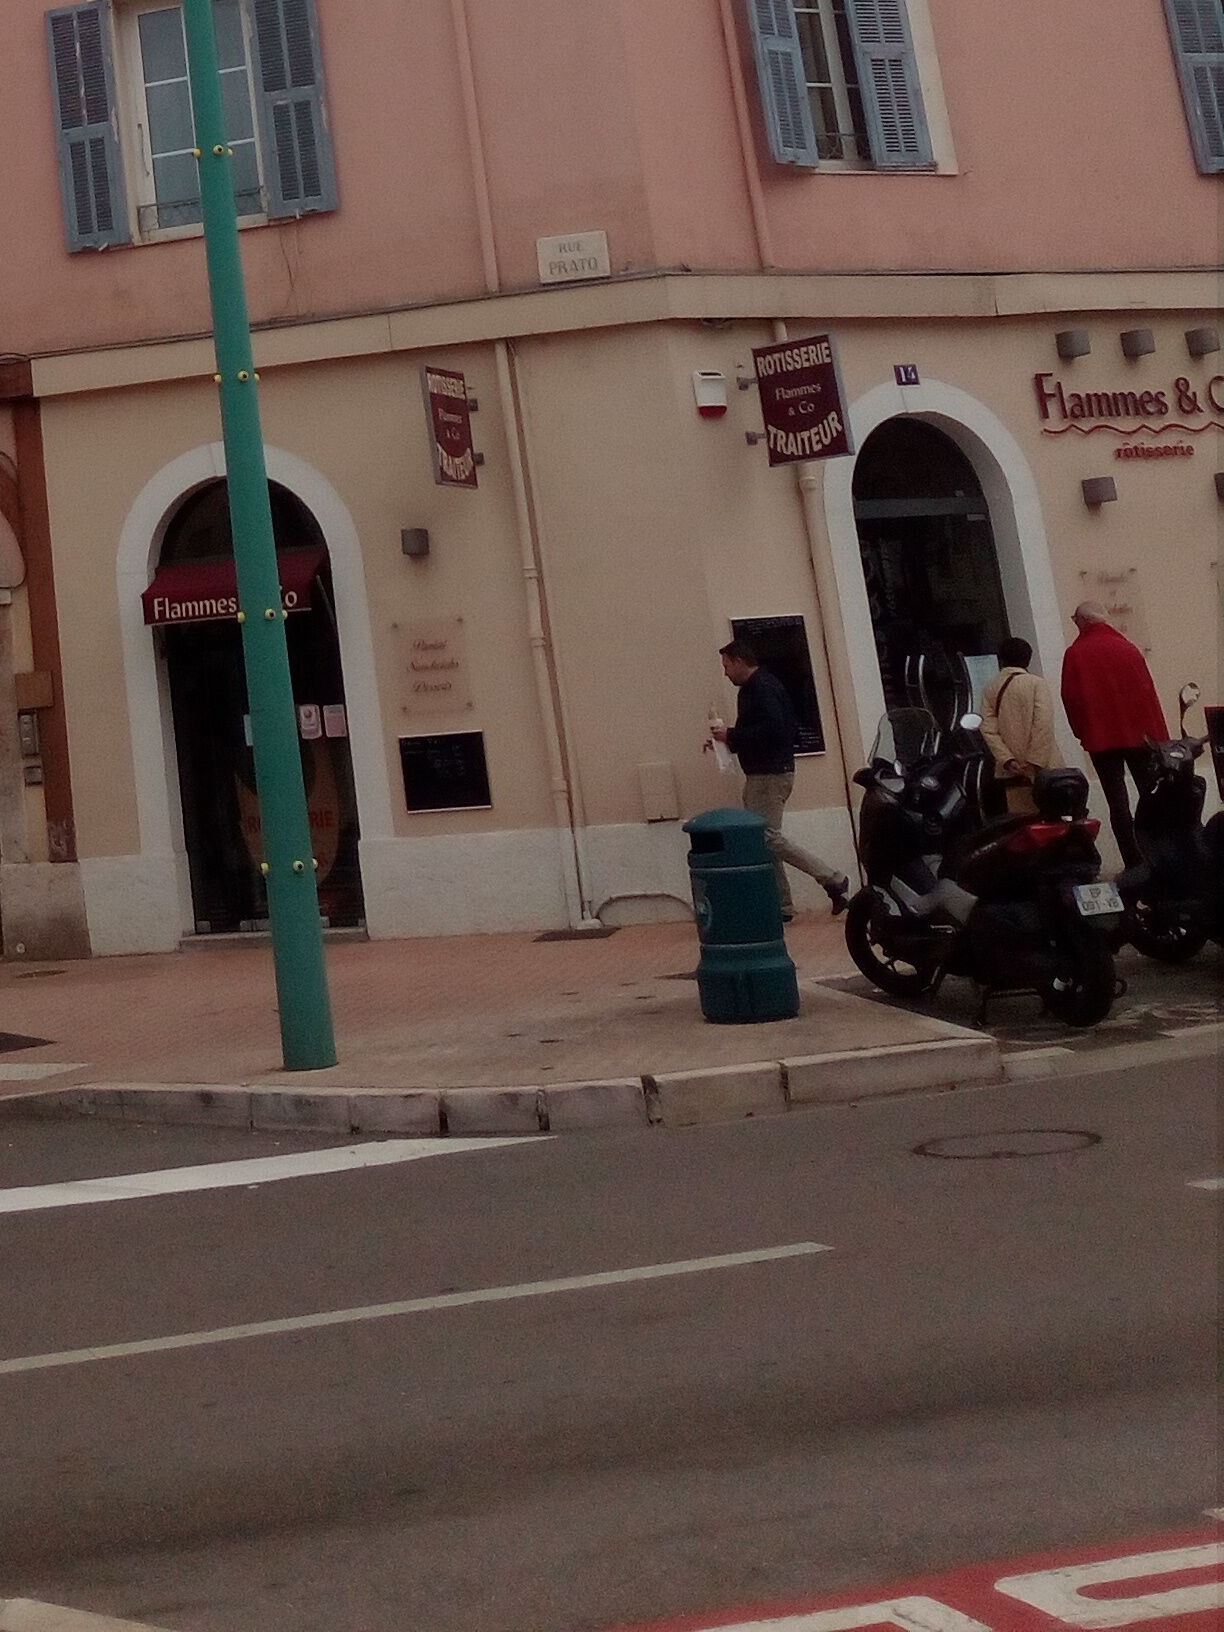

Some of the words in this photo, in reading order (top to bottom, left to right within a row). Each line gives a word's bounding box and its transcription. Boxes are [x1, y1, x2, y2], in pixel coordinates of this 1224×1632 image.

[558, 242, 583, 254] RUE
[548, 257, 599, 275] PRATO
[755, 341, 833, 378] ROTISSERIE
[898, 366, 916, 383] 14
[775, 383, 823, 401] Flammes
[1034, 372, 1169, 420] Flammes
[1174, 376, 1205, 416] &
[787, 406, 797, 417] &
[798, 400, 816, 415] Co
[767, 410, 844, 456] TRAITEUR
[152, 596, 238, 620] Flammes
